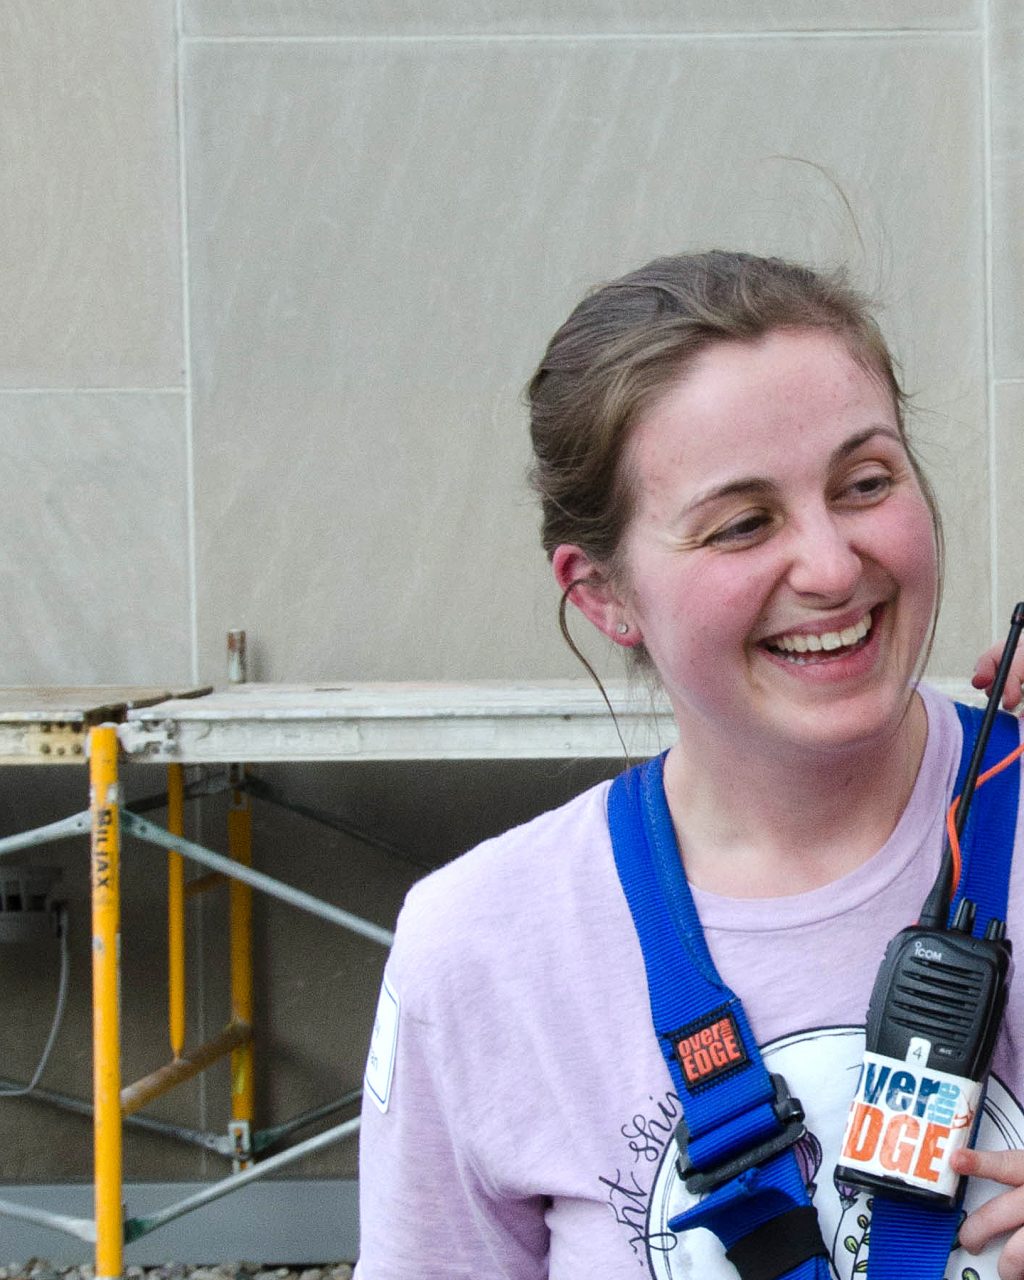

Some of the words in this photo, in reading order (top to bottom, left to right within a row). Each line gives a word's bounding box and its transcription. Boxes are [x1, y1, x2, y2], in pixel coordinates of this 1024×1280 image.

[678, 1023, 721, 1058] over
[682, 1035, 742, 1081] EDGE
[912, 1045, 923, 1061] 4
[856, 1063, 941, 1118] ver
[926, 1082, 961, 1126] the
[843, 1102, 951, 1183] DGE
